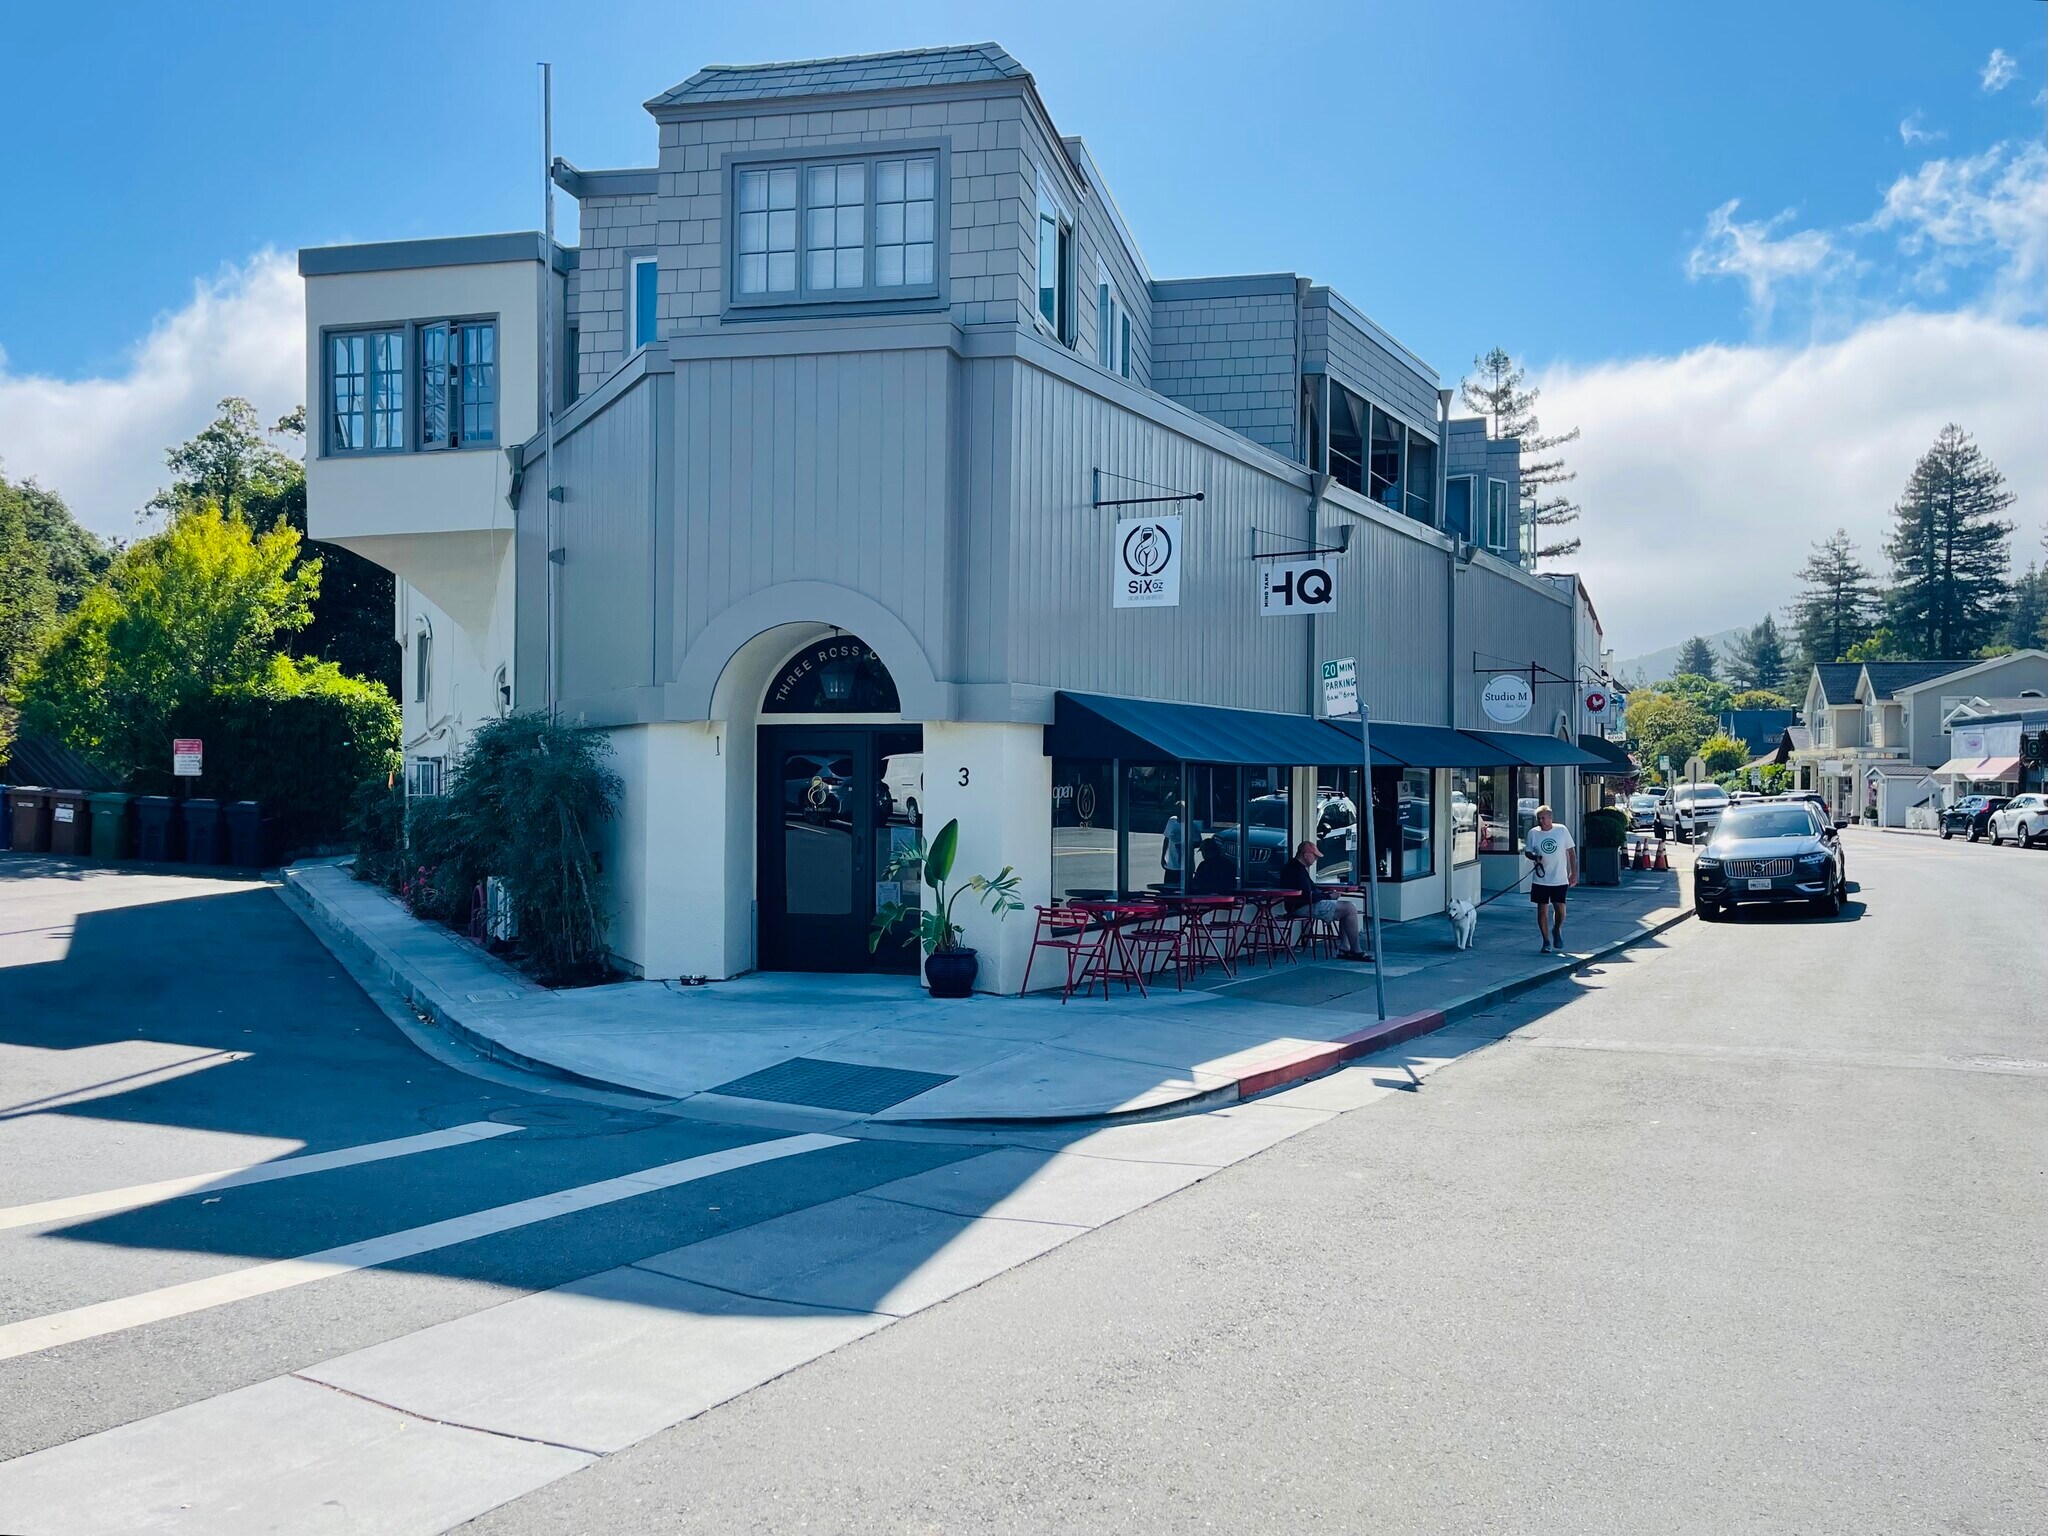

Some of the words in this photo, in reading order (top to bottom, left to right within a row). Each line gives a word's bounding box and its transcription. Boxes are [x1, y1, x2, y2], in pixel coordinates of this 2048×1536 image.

[776, 659, 812, 701] THREE
[818, 646, 860, 662] ROSS
[1324, 664, 1336, 677] 20
[1339, 663, 1353, 672] MIN
[1325, 678, 1355, 690] PARKING
[1485, 692, 1516, 701] Studio
[1518, 692, 1528, 701] M
[958, 767, 969, 787] 3
[1052, 785, 1073, 808] open
